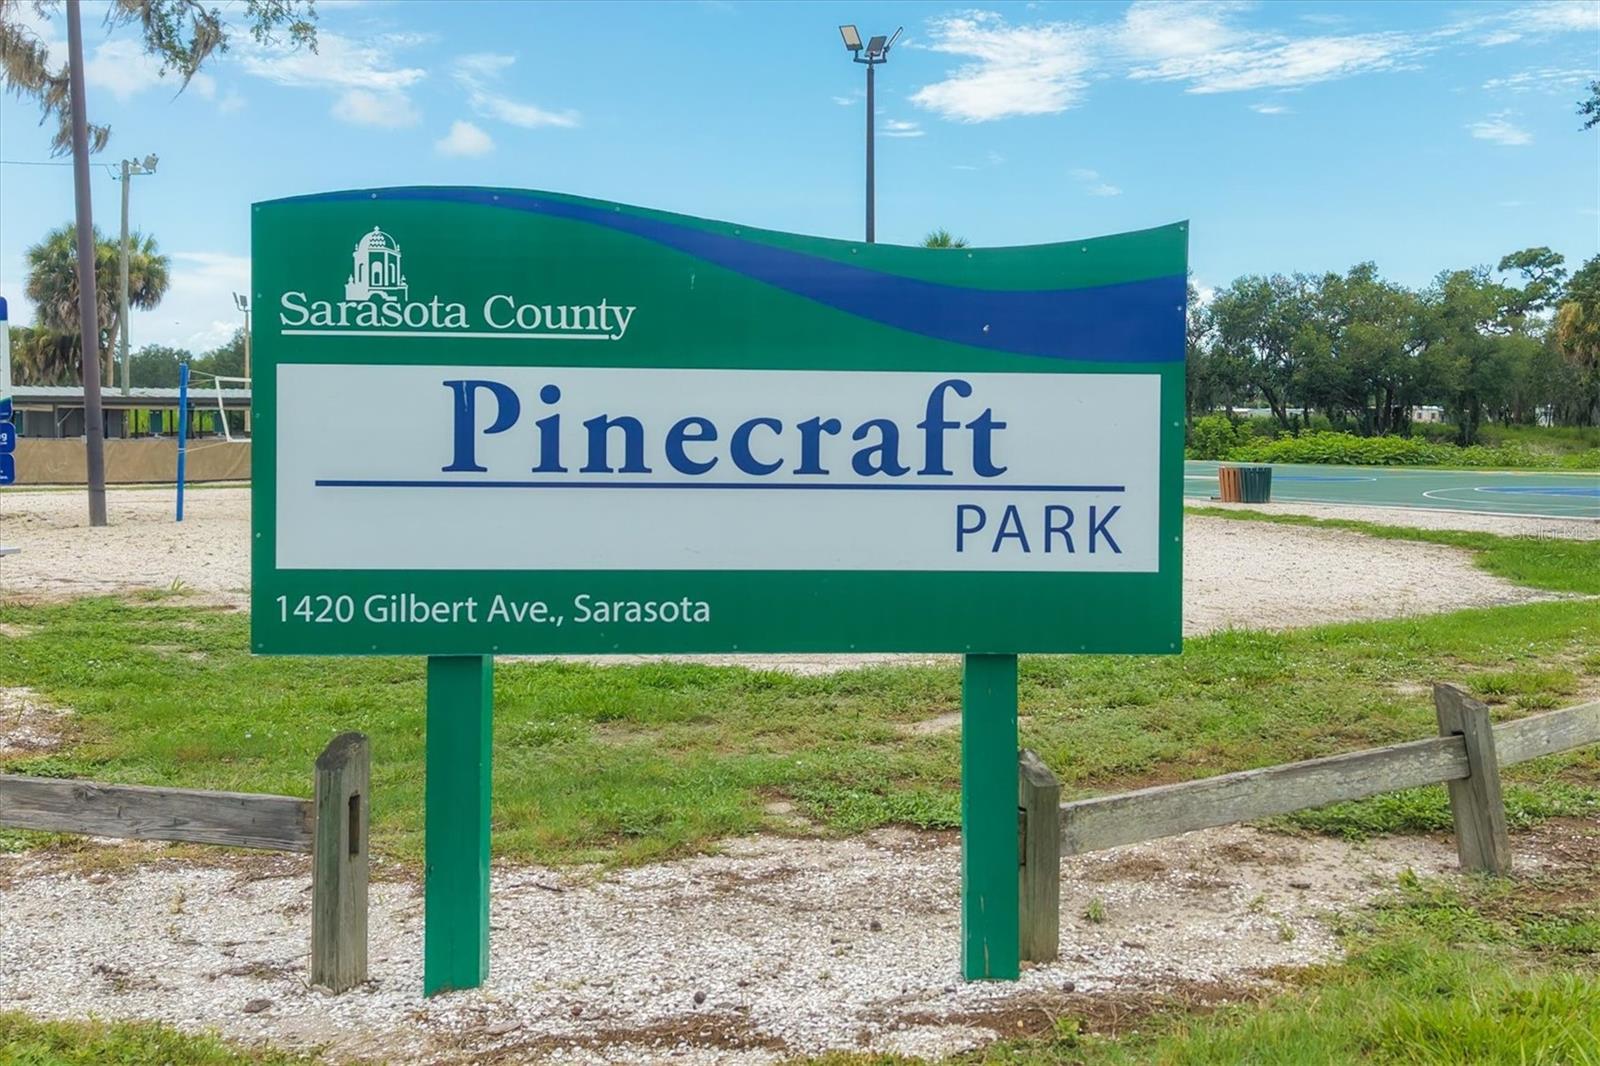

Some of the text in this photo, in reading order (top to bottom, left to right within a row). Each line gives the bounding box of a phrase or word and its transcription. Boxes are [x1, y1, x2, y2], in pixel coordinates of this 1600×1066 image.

[279, 291, 637, 341] Sarasota County
[441, 379, 1008, 477] Pinecraft
[956, 503, 1123, 554] PARK
[276, 594, 711, 627] 1420 Gilbert Ave., Sarasota
